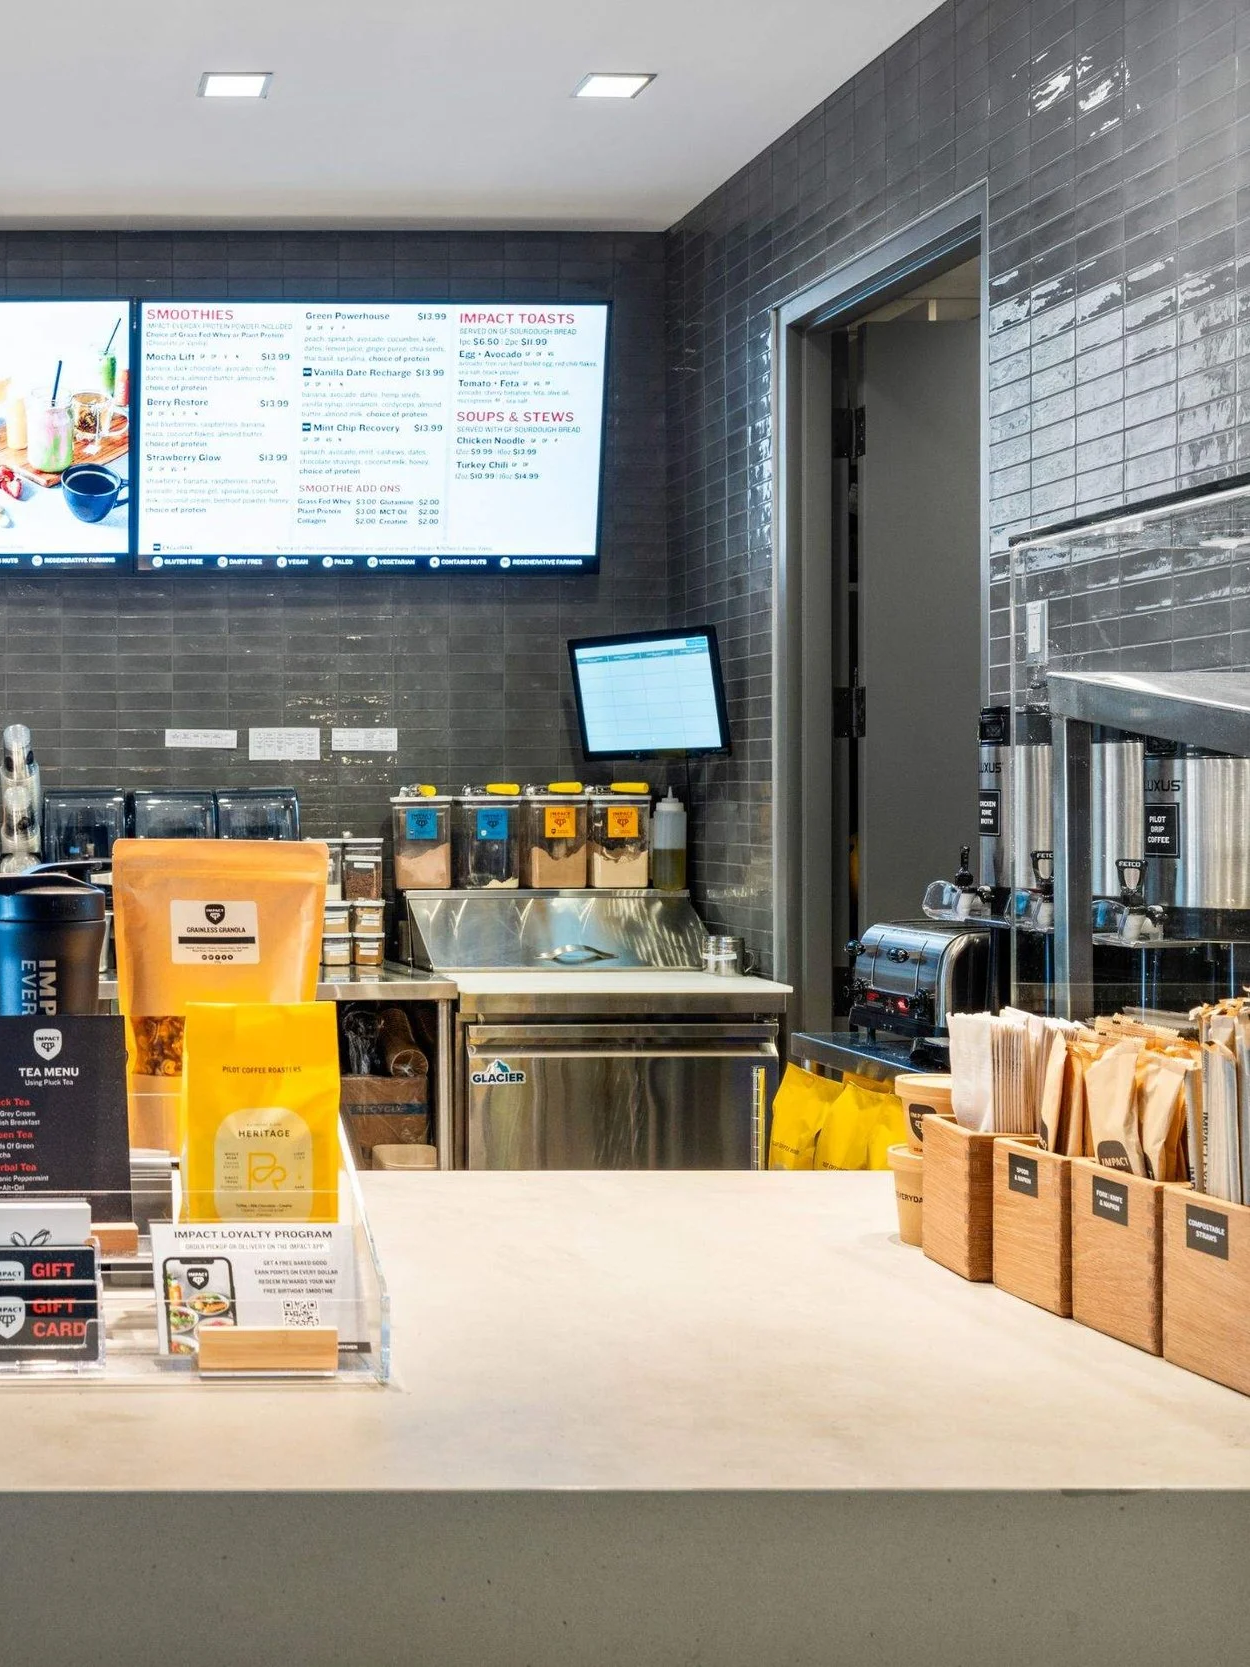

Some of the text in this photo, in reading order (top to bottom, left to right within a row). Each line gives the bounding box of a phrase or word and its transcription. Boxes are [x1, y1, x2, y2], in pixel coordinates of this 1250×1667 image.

[147, 310, 234, 320] SMOOTHIES
[460, 314, 575, 324] IMPACT TOASTS
[473, 338, 499, 346] $6.50
[521, 338, 547, 346] $11.99
[146, 353, 176, 361] Mocha
[261, 353, 290, 361] $13.99
[459, 351, 475, 359] Egg
[314, 369, 444, 379] Vanilla Date Recharge $13.99
[457, 412, 574, 423] SOUPS & STEWS
[313, 424, 400, 433] Mint Chip Recovery
[414, 424, 443, 432] $13.99
[457, 437, 525, 445] Chicken Noodle
[457, 461, 508, 470] Turkey Chili
[299, 485, 401, 493] SMOOTHIE ADD ONS
[22, 960, 37, 1015] EVER
[39, 960, 57, 1016] IMP
[19, 1068, 79, 1077] TEA MENU
[472, 1072, 524, 1084] GLACIER
[14, 1098, 30, 1106] Tea
[239, 1130, 290, 1138] HERITAGE
[1101, 1157, 1128, 1166] IMPACT
[896, 1191, 923, 1204] EVERYDA
[1188, 1218, 1225, 1236] COMPOSTABLE
[174, 1231, 216, 1239] IMPACT
[1196, 1231, 1217, 1243] STRAWS
[31, 1262, 75, 1278] GIFT
[32, 1298, 75, 1313] GIFT
[33, 1322, 86, 1337] CARD
